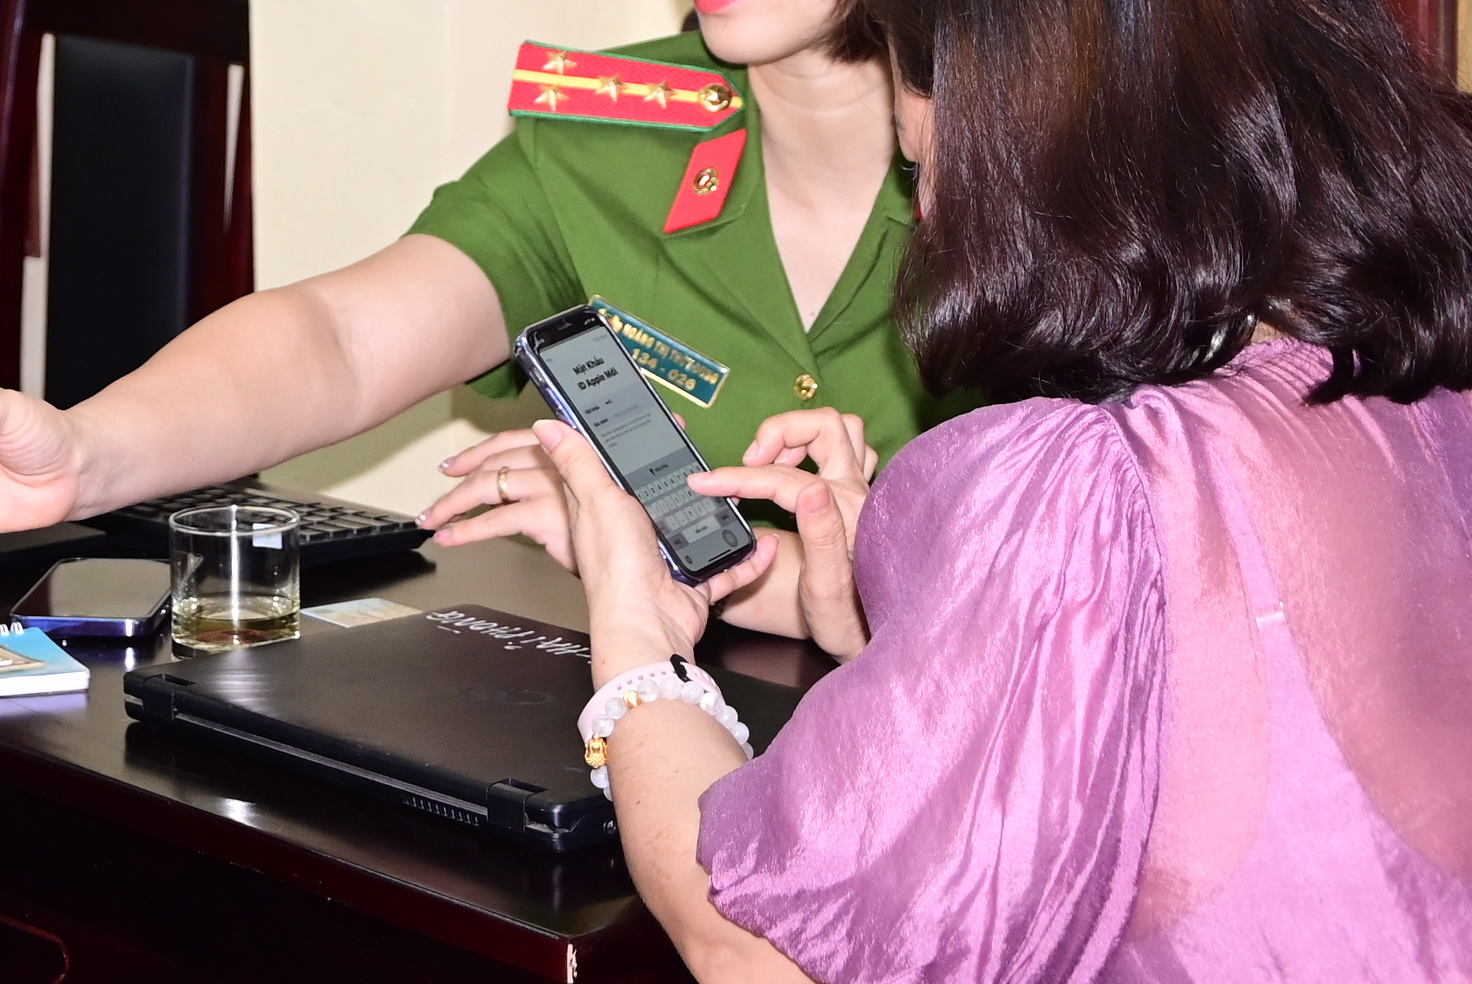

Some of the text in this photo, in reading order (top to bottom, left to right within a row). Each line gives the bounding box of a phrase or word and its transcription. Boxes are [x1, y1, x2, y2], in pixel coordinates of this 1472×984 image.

[577, 381, 587, 391] ID
[587, 373, 606, 387] Apple
[632, 348, 659, 369] 134
[668, 368, 697, 391] 026
